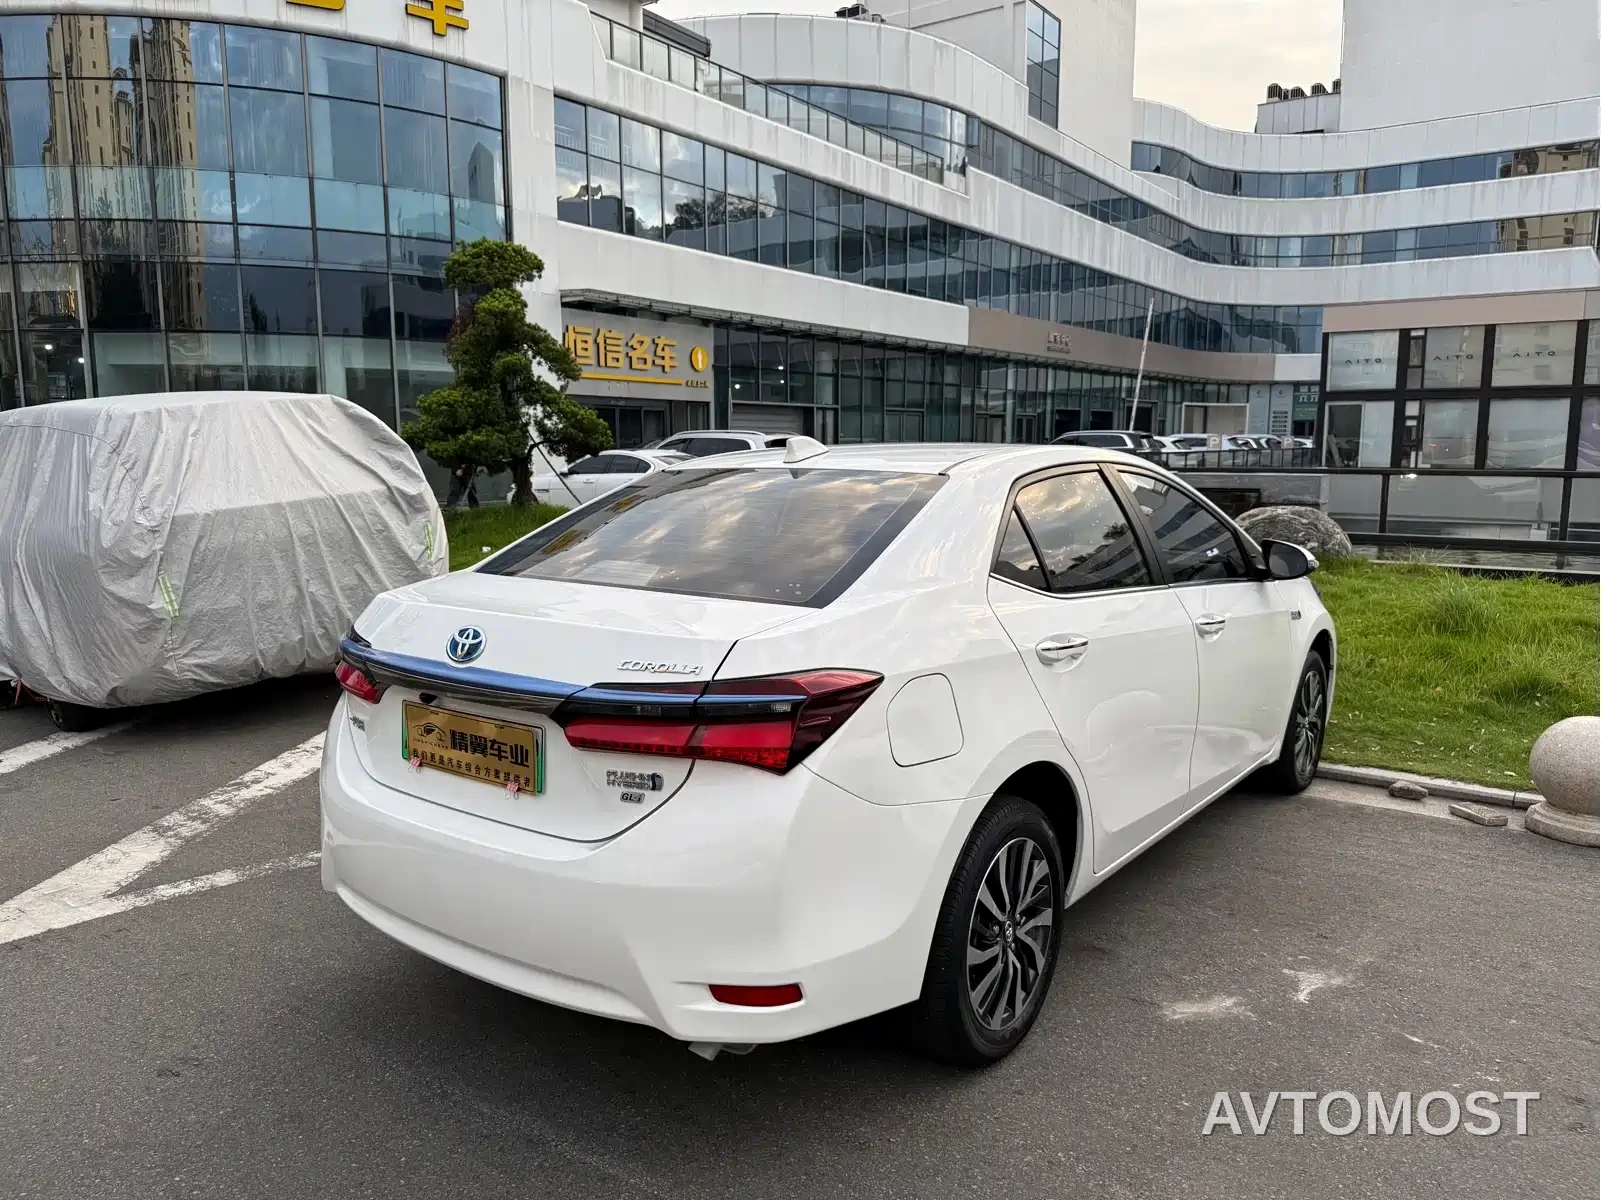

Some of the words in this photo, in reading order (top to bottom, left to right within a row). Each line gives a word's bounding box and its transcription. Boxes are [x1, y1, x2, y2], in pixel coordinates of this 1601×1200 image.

[563, 325, 679, 373] 恒信名车
[1513, 350, 1556, 358] AITO
[1344, 357, 1382, 365] AITO
[616, 659, 704, 676] COROLLA
[449, 729, 530, 768] 精翼车业
[606, 778, 651, 790] HYBRID
